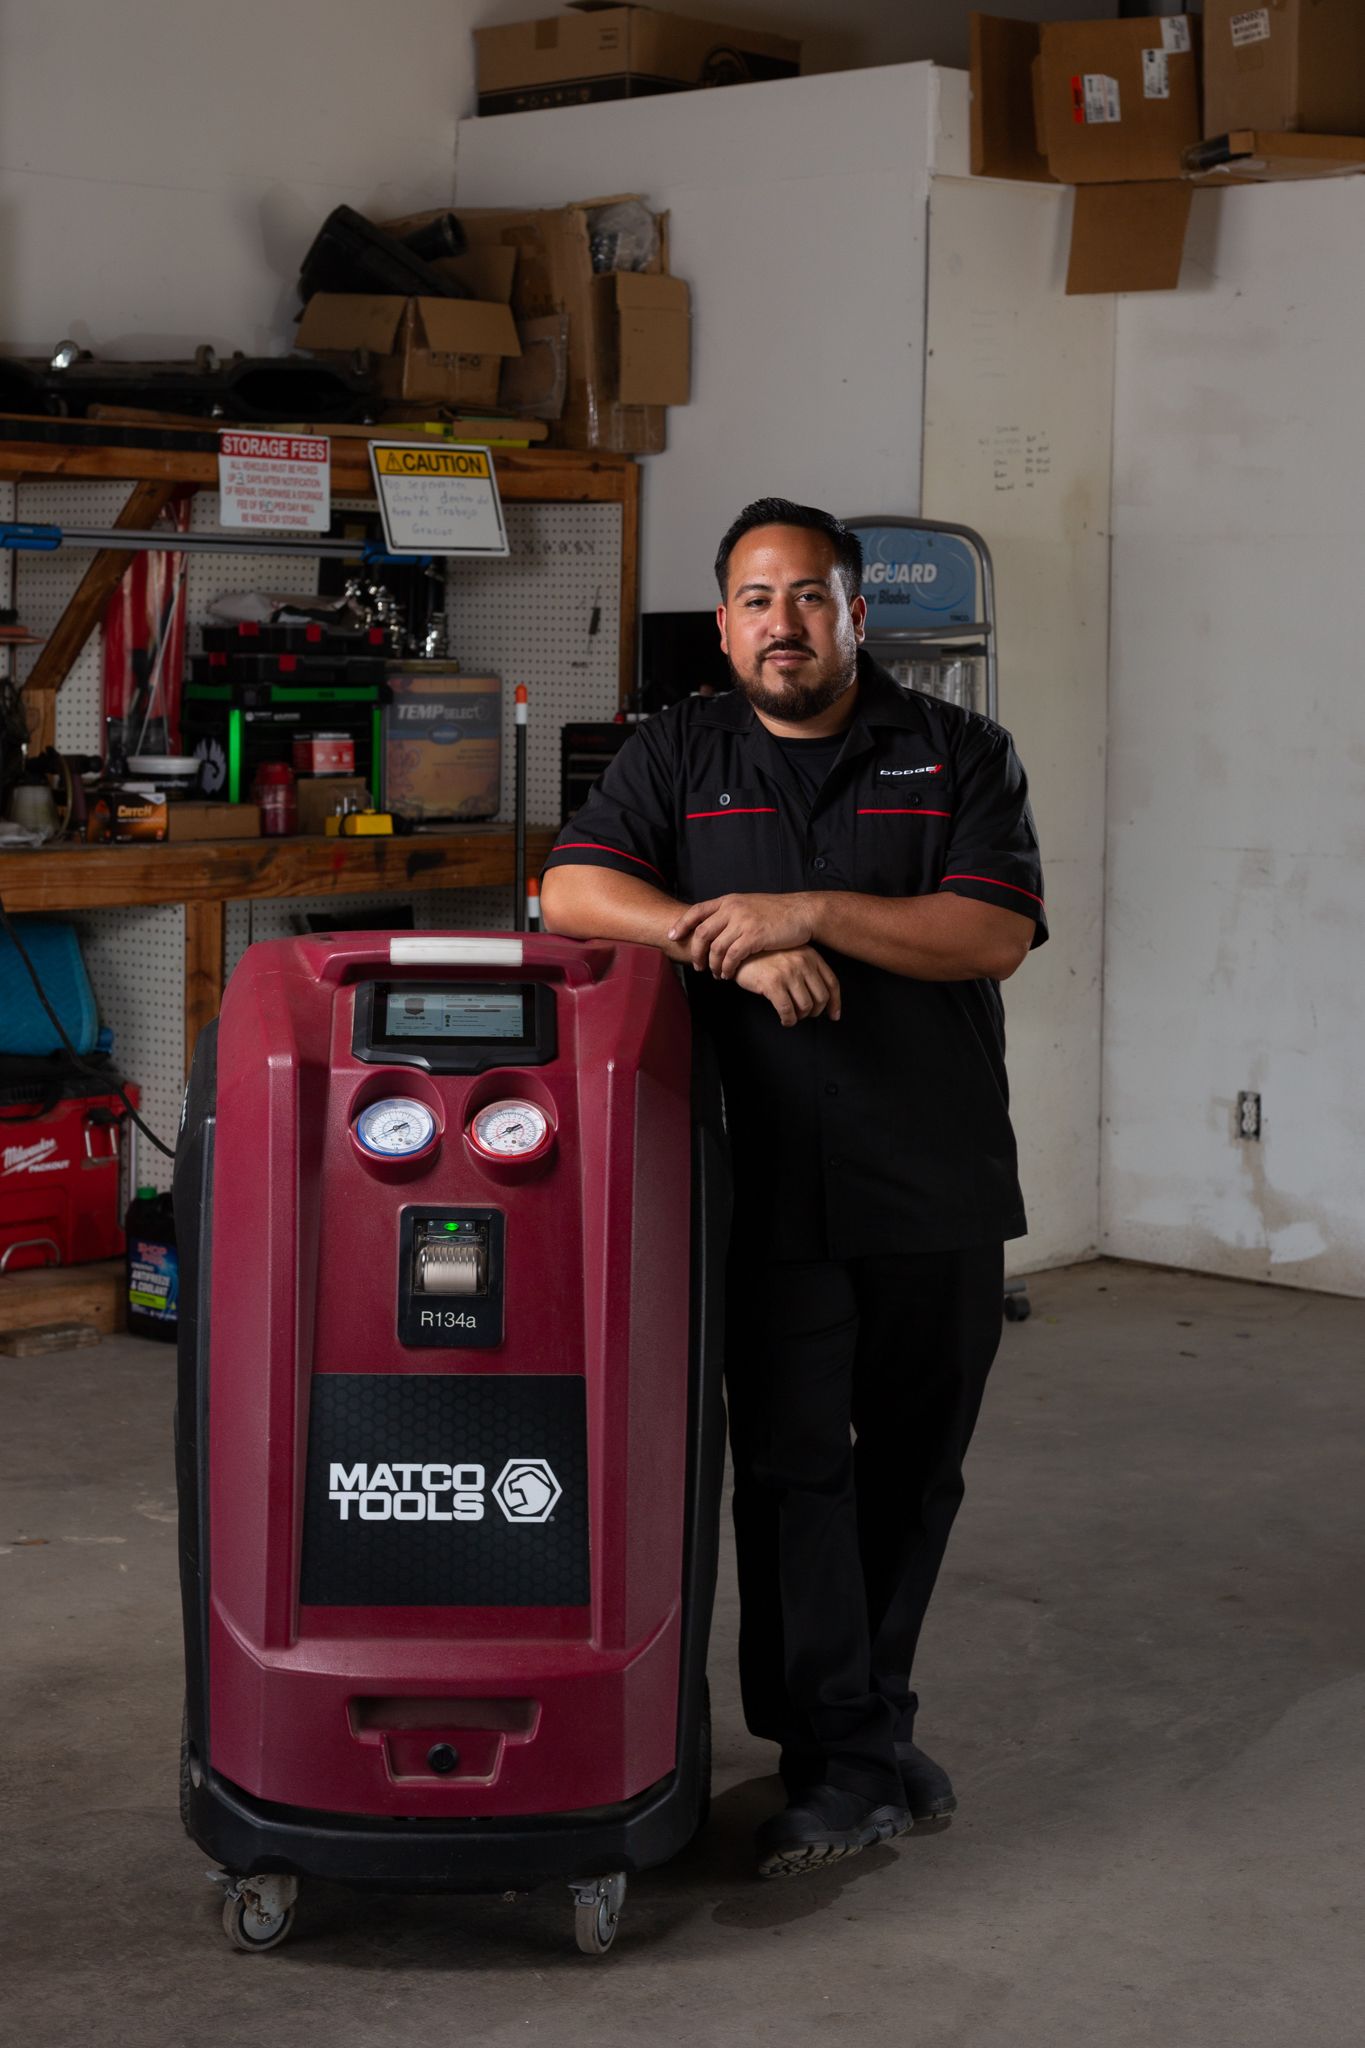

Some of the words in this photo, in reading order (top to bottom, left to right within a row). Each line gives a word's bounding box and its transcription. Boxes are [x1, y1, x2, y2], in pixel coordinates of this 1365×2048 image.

[222, 436, 288, 457] STORAGE
[291, 441, 325, 460] FEES
[243, 462, 269, 472] VEHICLES
[271, 463, 287, 473] MUST
[402, 453, 482, 473] CAUTION
[247, 474, 261, 483] DAYS
[261, 475, 280, 485] AFTER
[282, 477, 320, 488] NOTIFICATION
[297, 490, 323, 501] STORAGE
[251, 514, 267, 523] MADE
[861, 562, 937, 583] NGUARD
[878, 589, 911, 605] Blades
[880, 766, 936, 776] DODGE
[420, 1310, 477, 1328] R134a
[329, 1463, 486, 1491] MATCO
[328, 1491, 485, 1521] TOOLS
